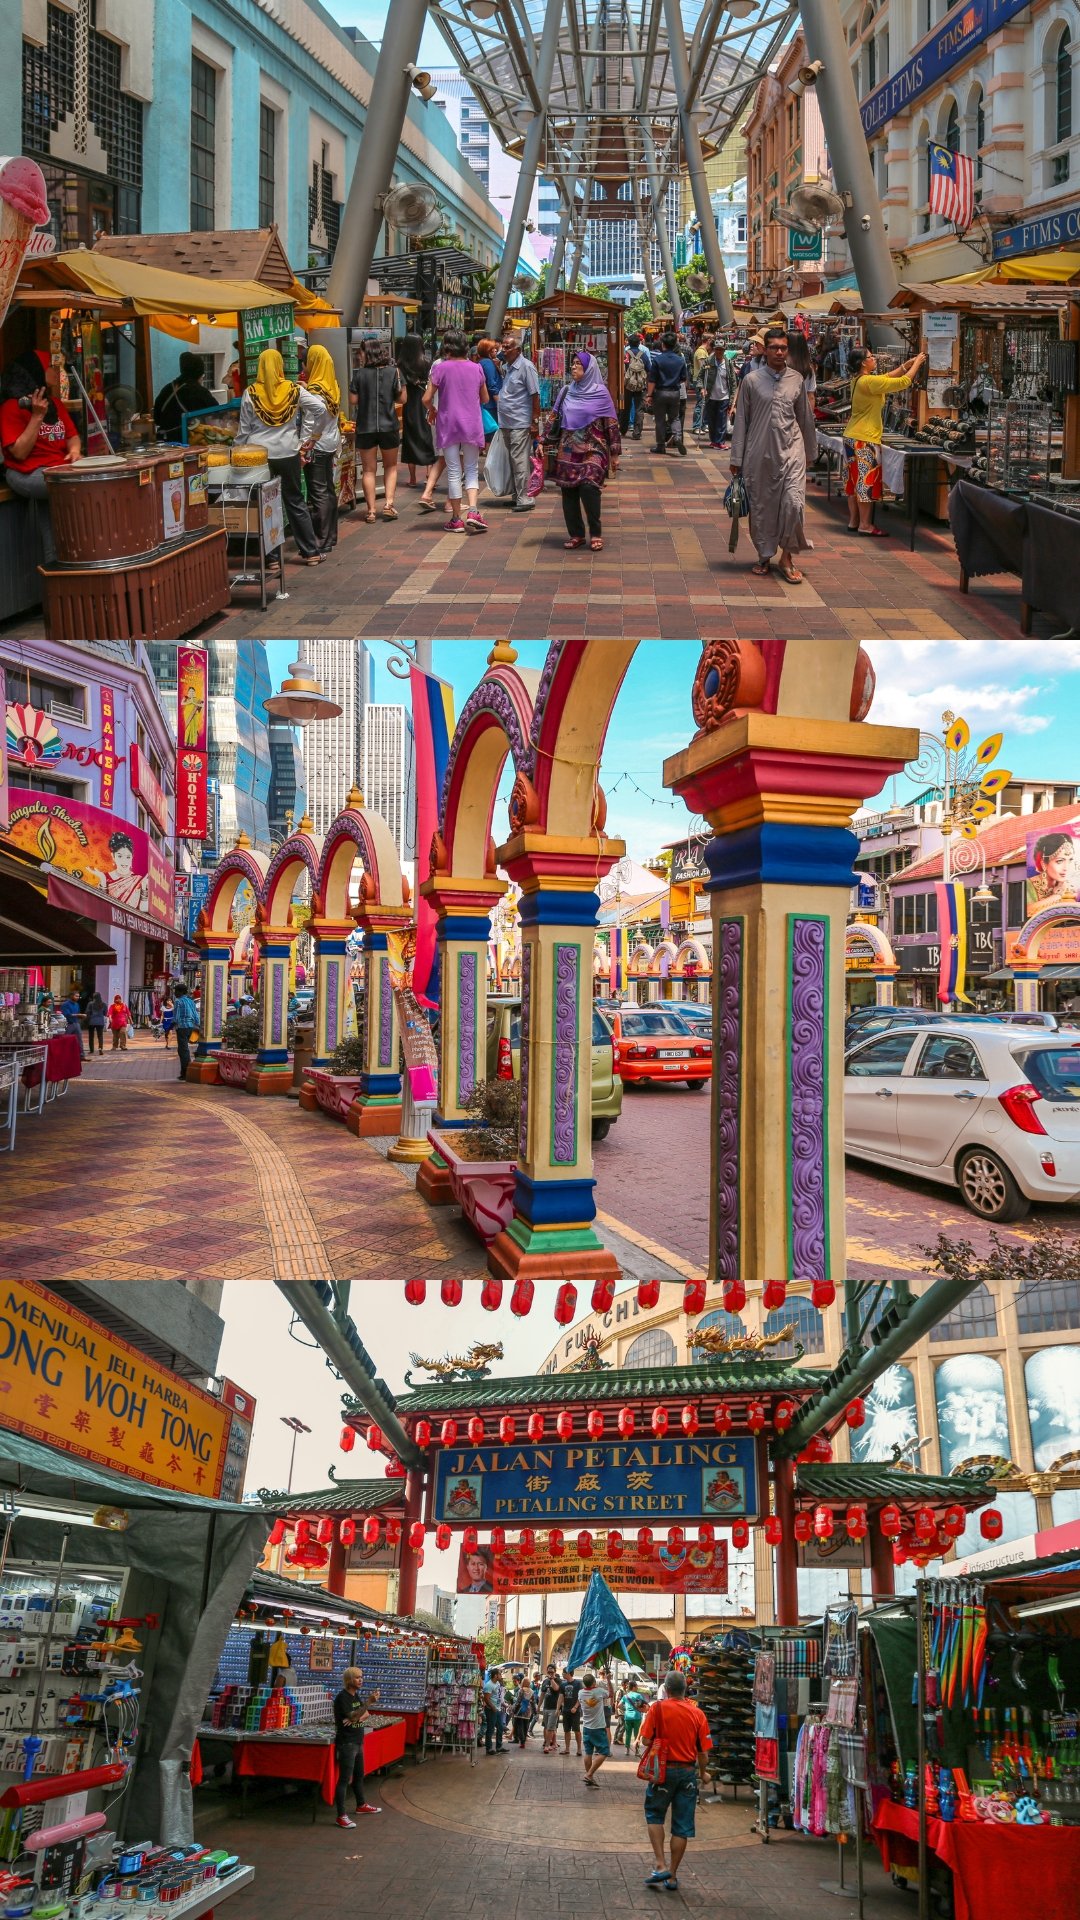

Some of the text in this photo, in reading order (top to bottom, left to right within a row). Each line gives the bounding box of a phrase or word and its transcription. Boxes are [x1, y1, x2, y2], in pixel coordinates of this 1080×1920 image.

[938, 20, 963, 60] FTMS
[891, 57, 924, 110] FTMS
[1023, 217, 1061, 248] FTMS
[244, 319, 265, 340] RM
[103, 703, 114, 787] SALES
[927, 946, 941, 967] TB
[4, 1292, 188, 1414] MENJUAL JELI HARBA
[84, 1365, 147, 1429] WOH
[160, 1408, 213, 1462] TONG
[451, 1443, 738, 1474] JALAN PETALING
[495, 1494, 688, 1514] PETALING STREET
[969, 1551, 1024, 1573] infrastructure
[513, 1576, 551, 1586] SENATOR
[553, 1576, 576, 1584] TUAN
[608, 1576, 624, 1584] SIN
[625, 1576, 655, 1585] WOON
